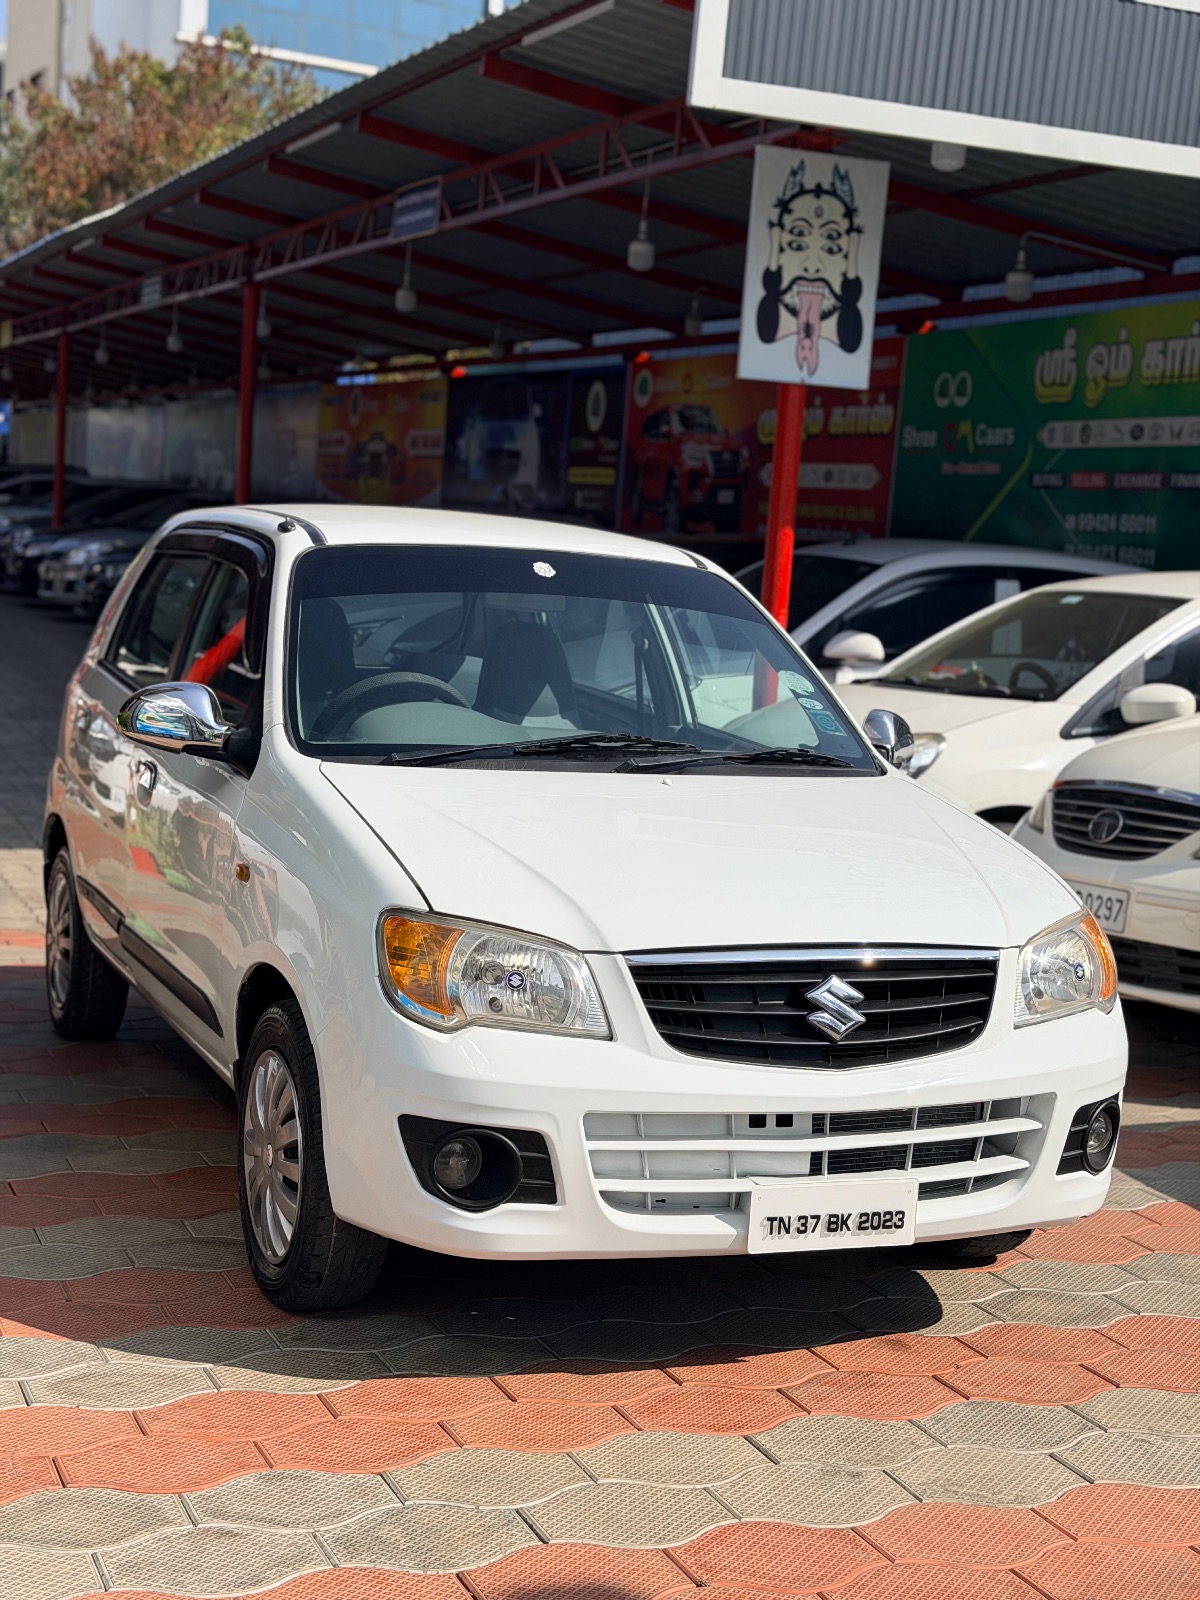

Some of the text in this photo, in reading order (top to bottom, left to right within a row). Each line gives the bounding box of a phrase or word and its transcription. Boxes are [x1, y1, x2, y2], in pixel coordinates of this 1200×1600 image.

[902, 424, 938, 448] Shree
[1113, 472, 1163, 488] EXCHANGE
[766, 1210, 906, 1235] TN 37 BK 2023
